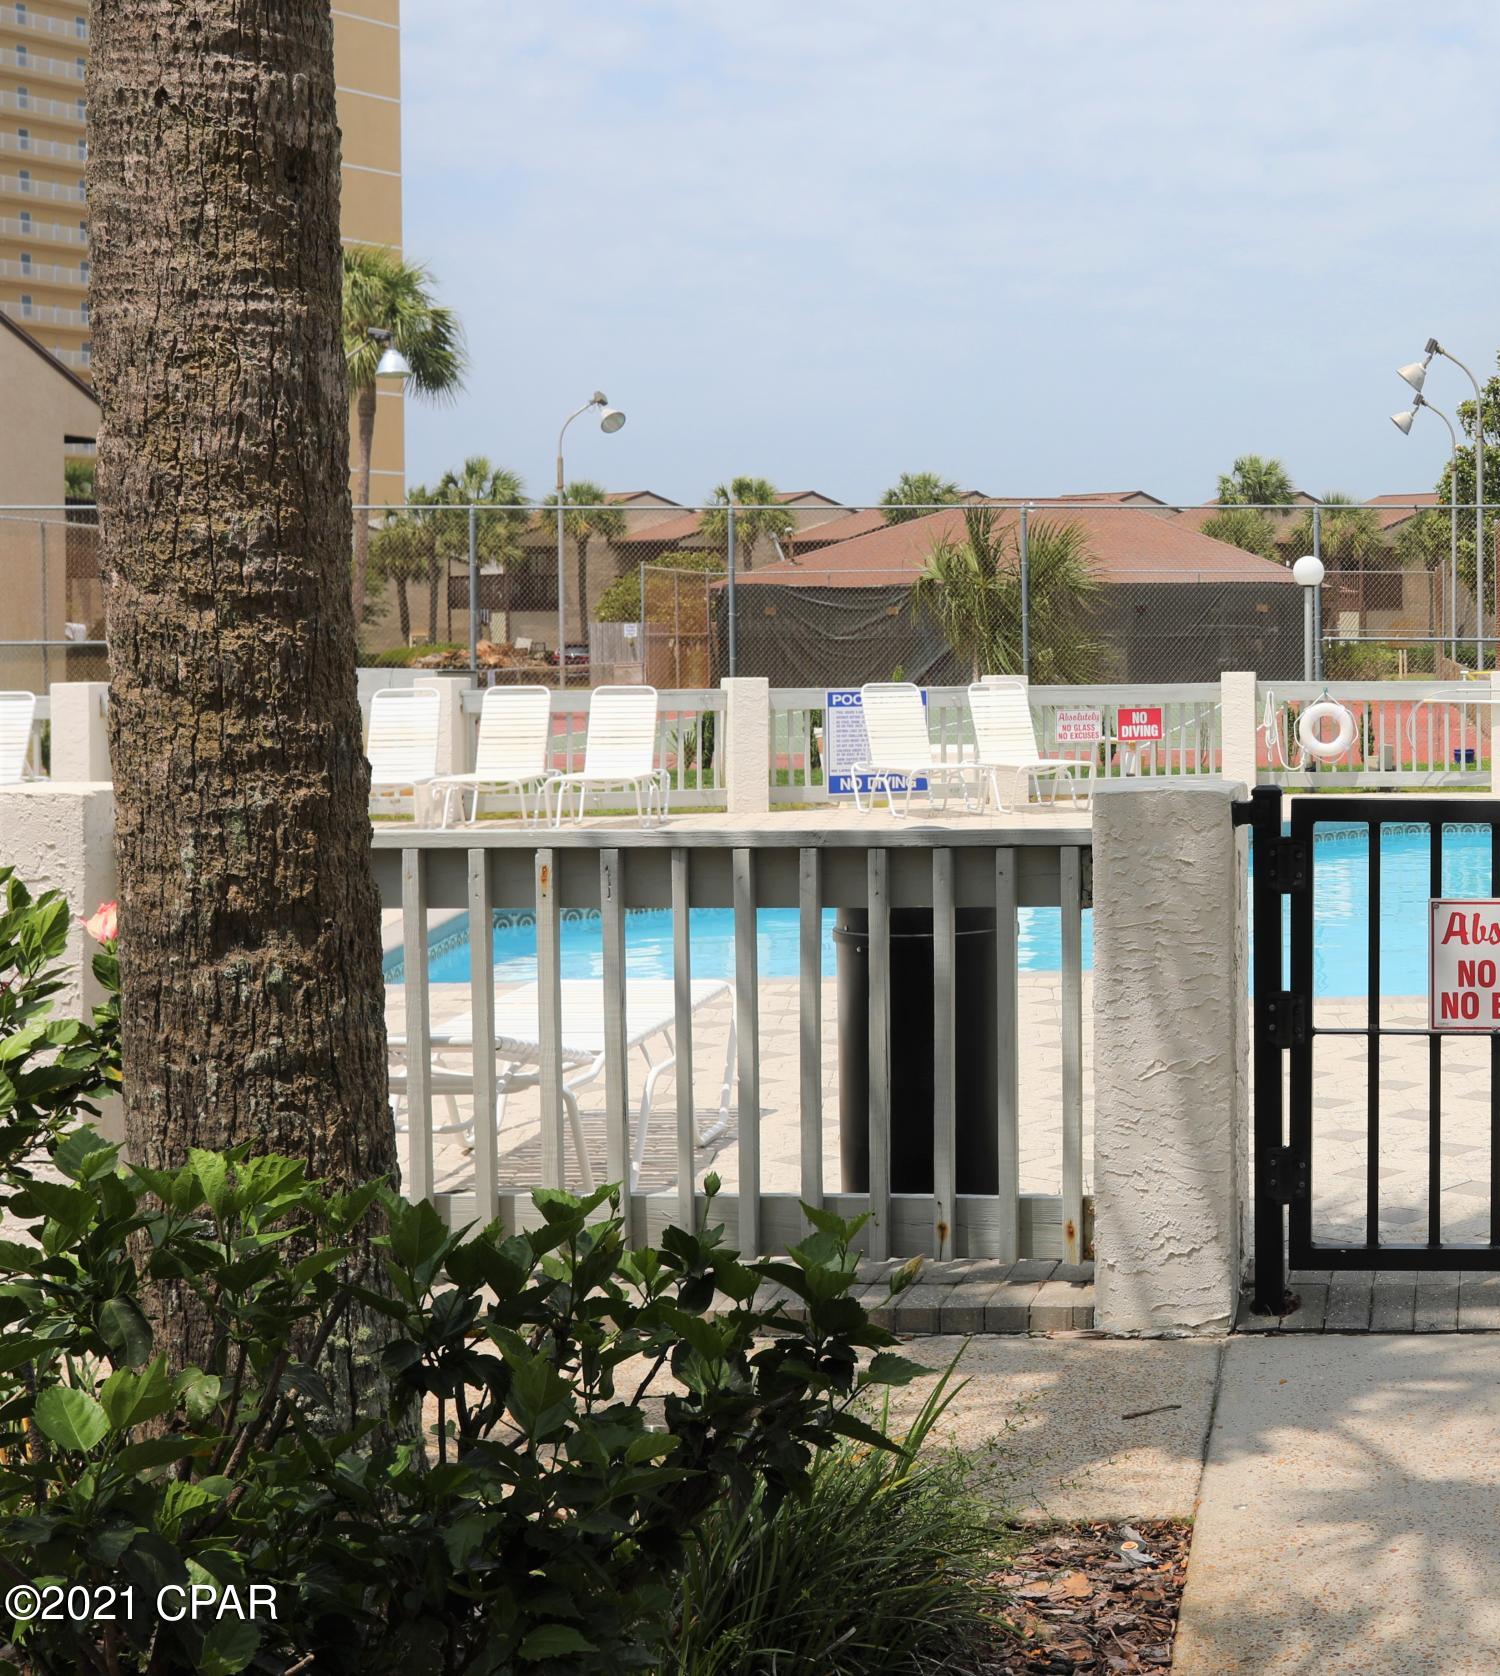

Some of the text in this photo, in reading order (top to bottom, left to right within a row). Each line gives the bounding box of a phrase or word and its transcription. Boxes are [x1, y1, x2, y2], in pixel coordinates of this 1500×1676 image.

[1058, 712, 1099, 721] Absolutely
[1132, 712, 1147, 724] NO
[1061, 724, 1072, 732] NO
[1122, 725, 1159, 737] DIVING
[1058, 731, 1099, 740] NO EXCUSES
[840, 777, 862, 790] NO
[1457, 959, 1496, 988] NO
[1441, 991, 1480, 1020] NO
